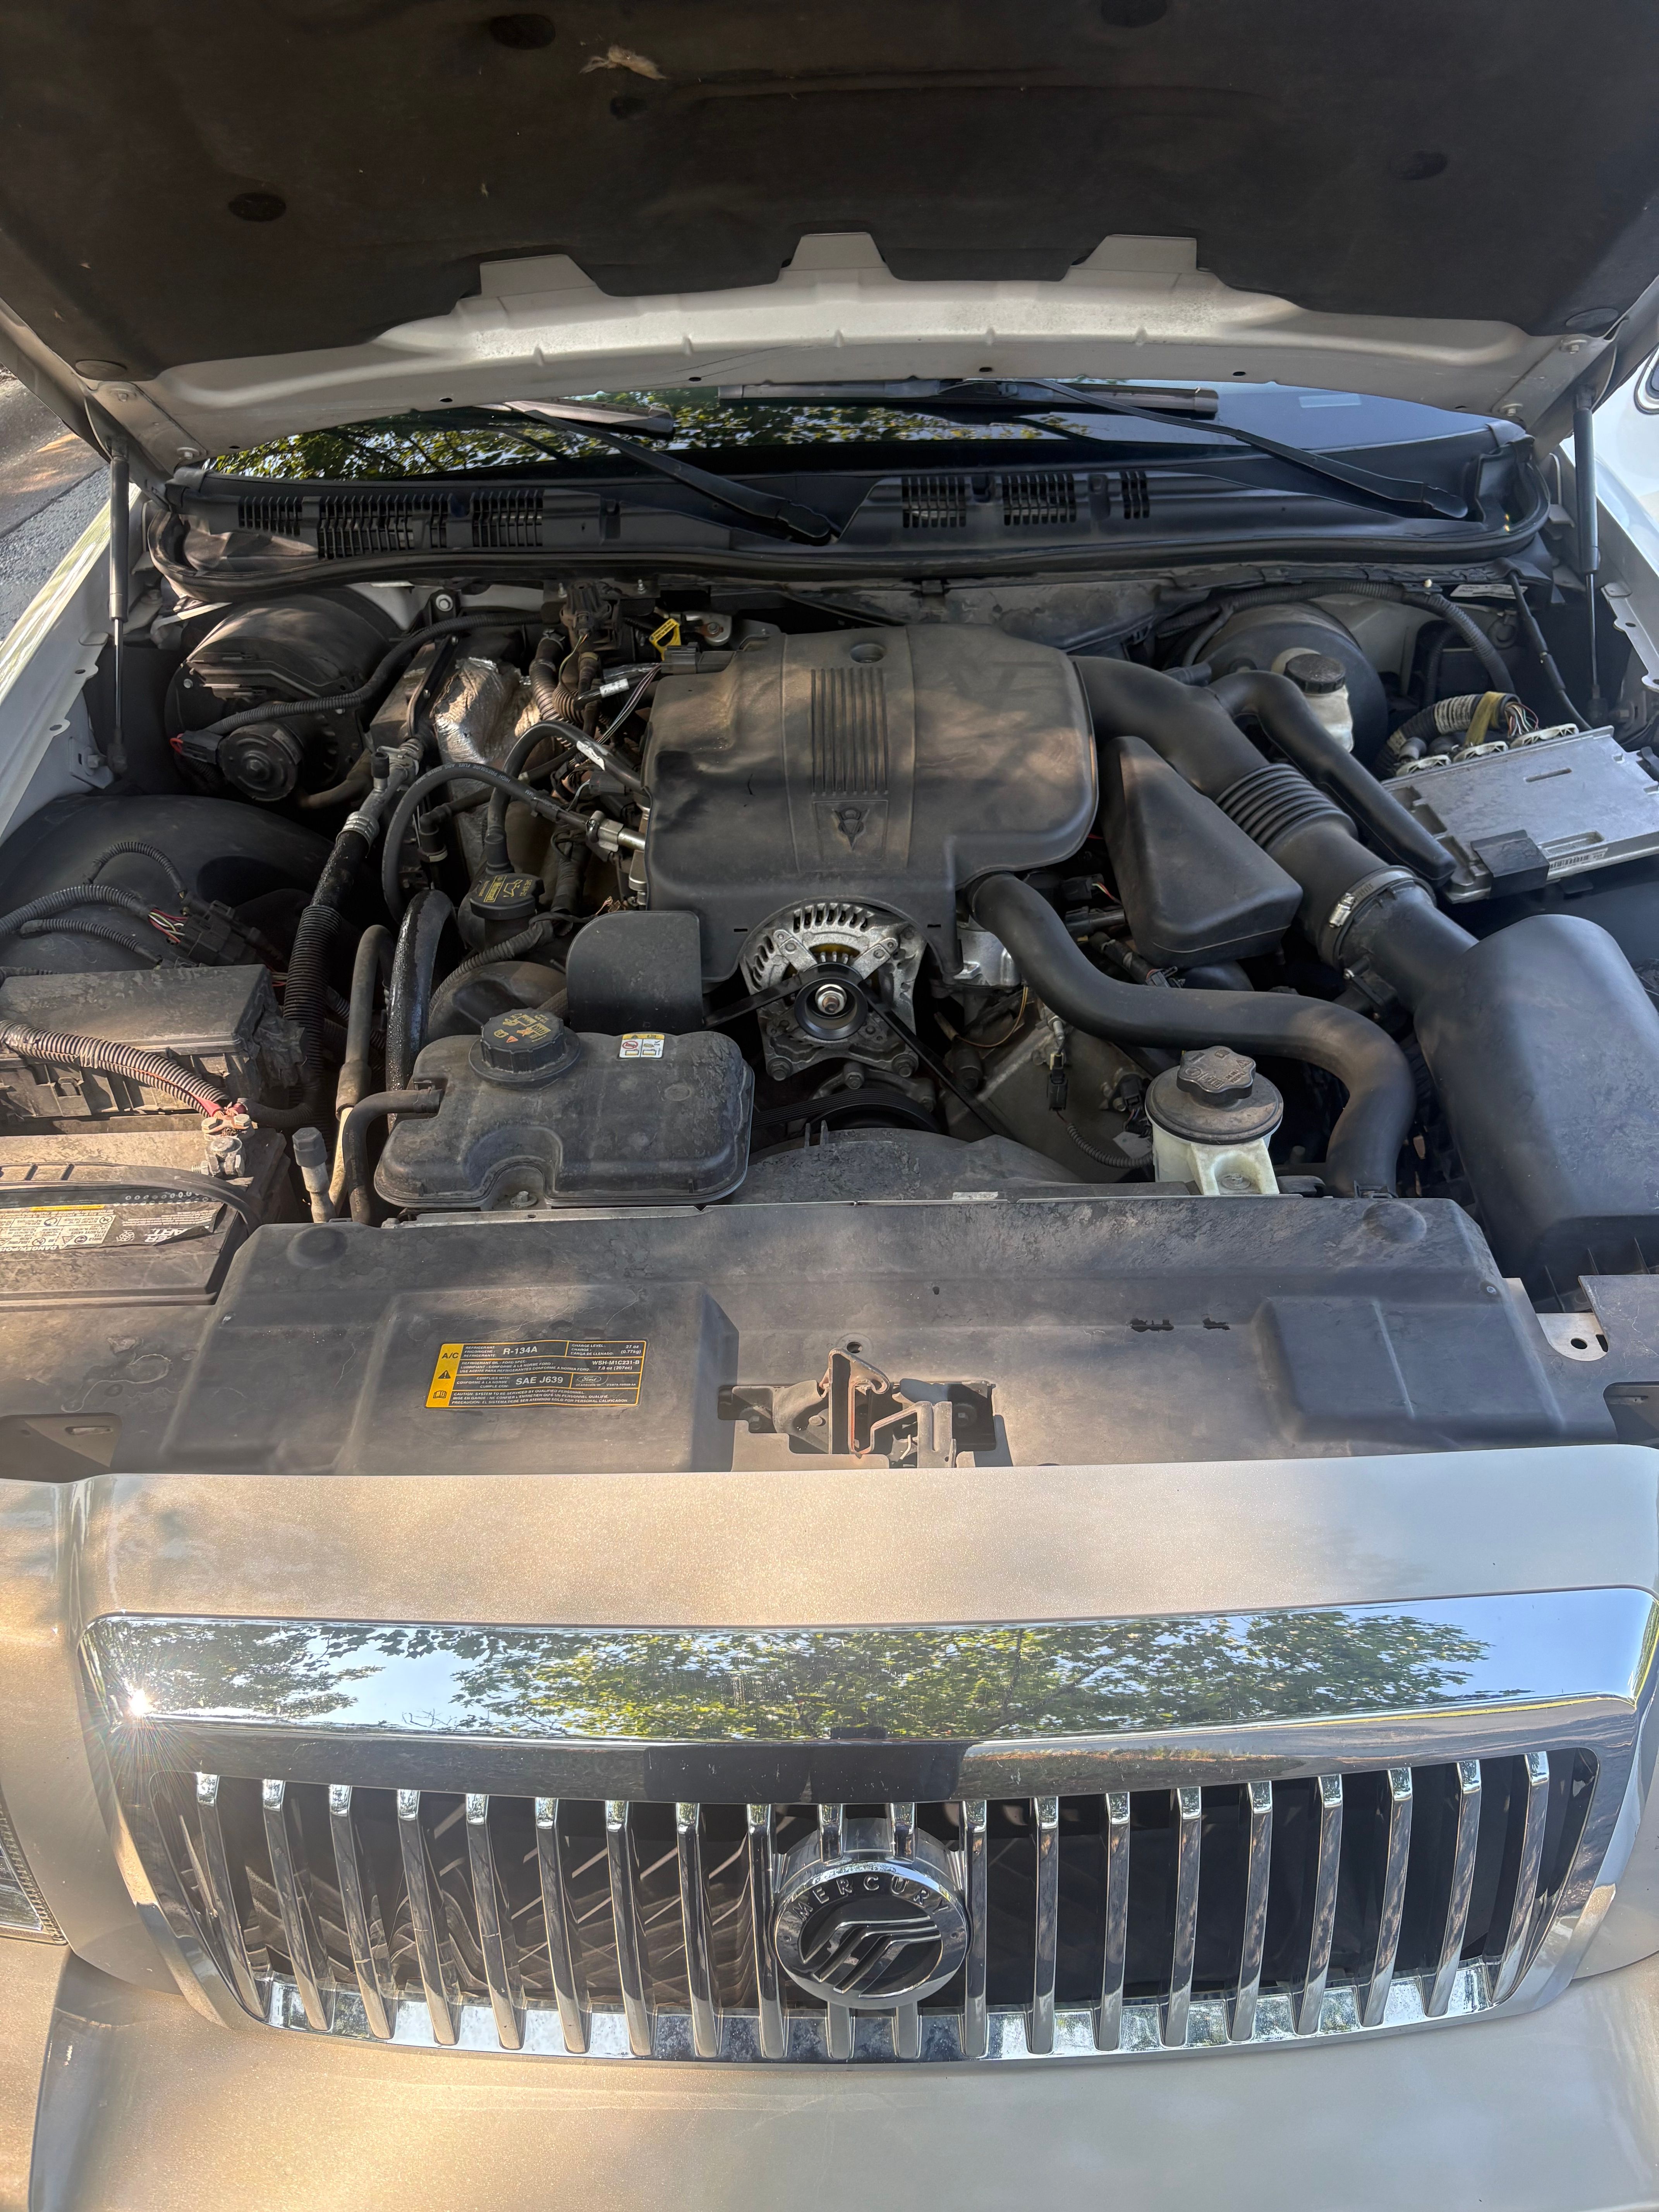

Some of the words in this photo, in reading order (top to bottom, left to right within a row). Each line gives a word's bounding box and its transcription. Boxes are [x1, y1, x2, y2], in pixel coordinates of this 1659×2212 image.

[503, 1346, 538, 1355] R-134A
[515, 1377, 537, 1385] SAE
[792, 1874, 949, 1922] MERCURY
